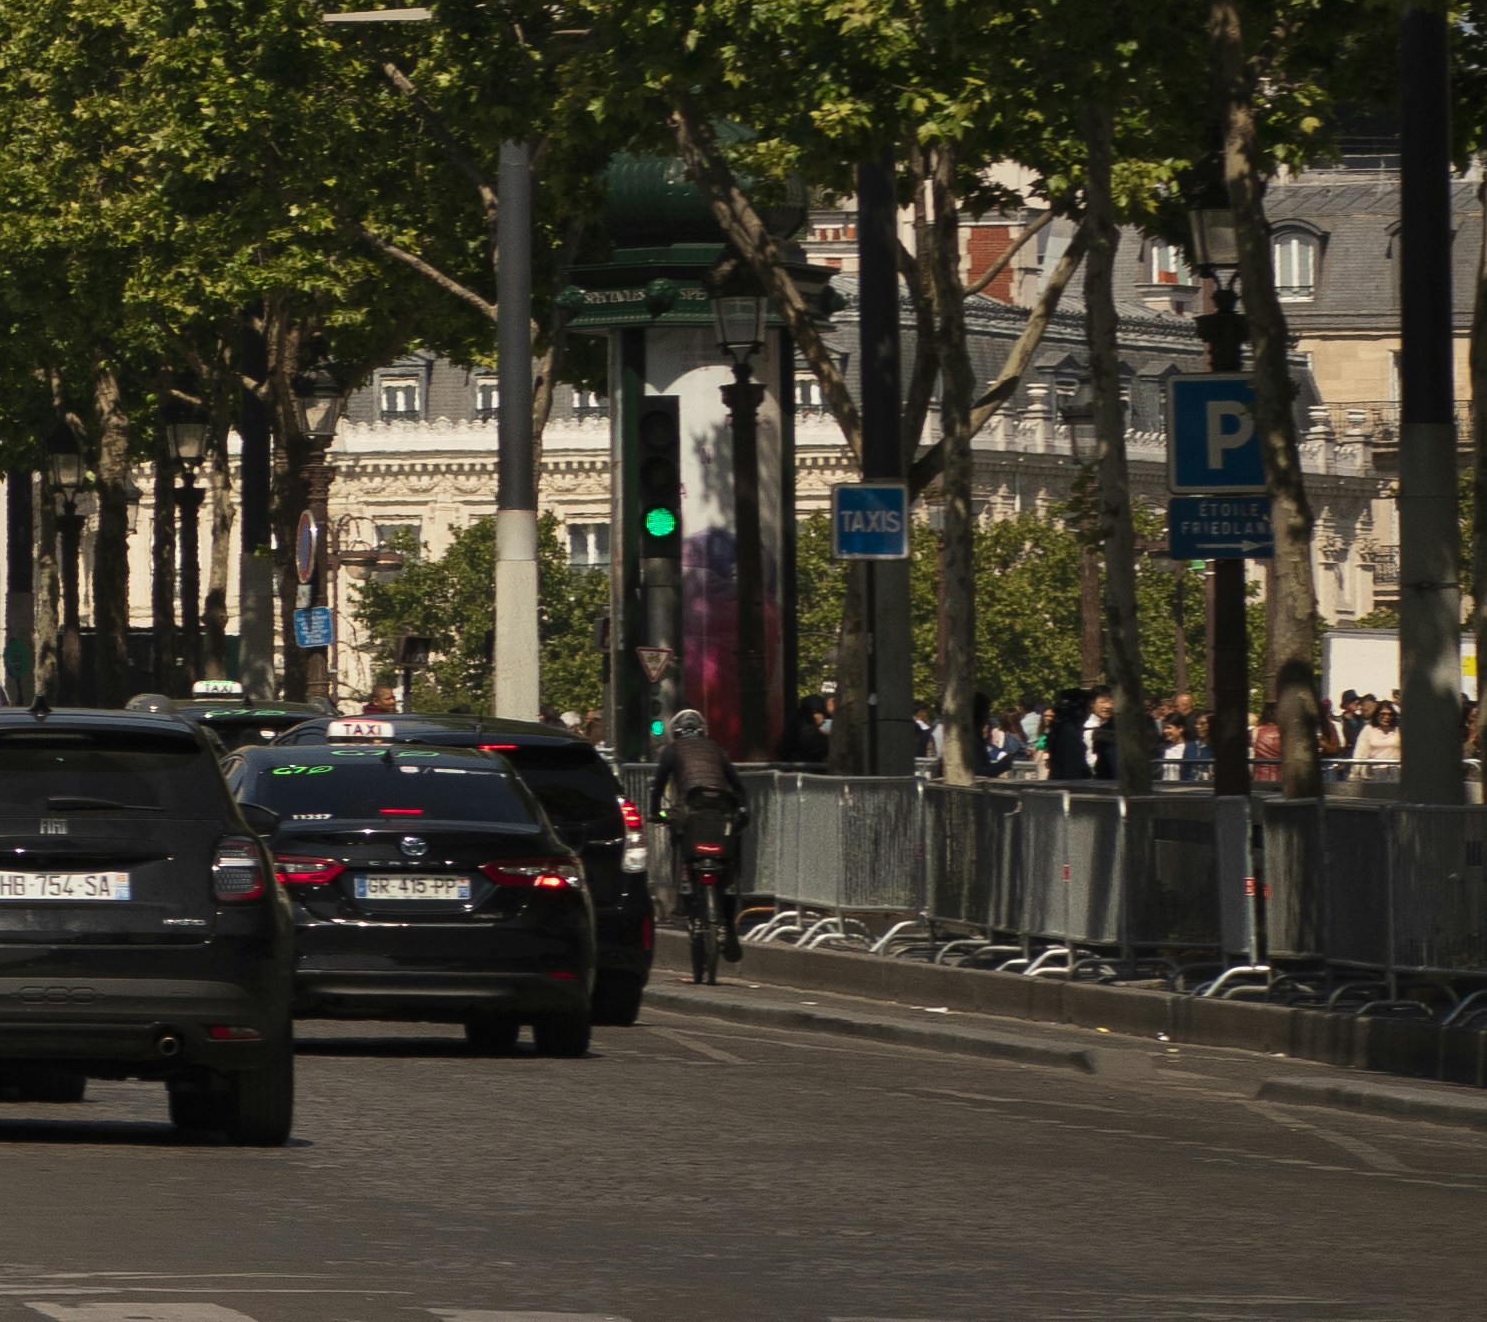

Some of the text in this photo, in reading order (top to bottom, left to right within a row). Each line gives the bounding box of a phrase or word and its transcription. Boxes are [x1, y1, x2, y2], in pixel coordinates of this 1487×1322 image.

[1205, 399, 1255, 470] P
[1199, 501, 1260, 517] ÉTOILE
[840, 510, 900, 533] TAXIS
[1181, 521, 1271, 535] FRIEDLAN
[205, 684, 233, 693] TAXI
[343, 723, 382, 736] TAXI
[39, 818, 68, 835] FIAT
[0, 875, 111, 897] HB-754-SA
[368, 878, 457, 894] GR-415-PP
